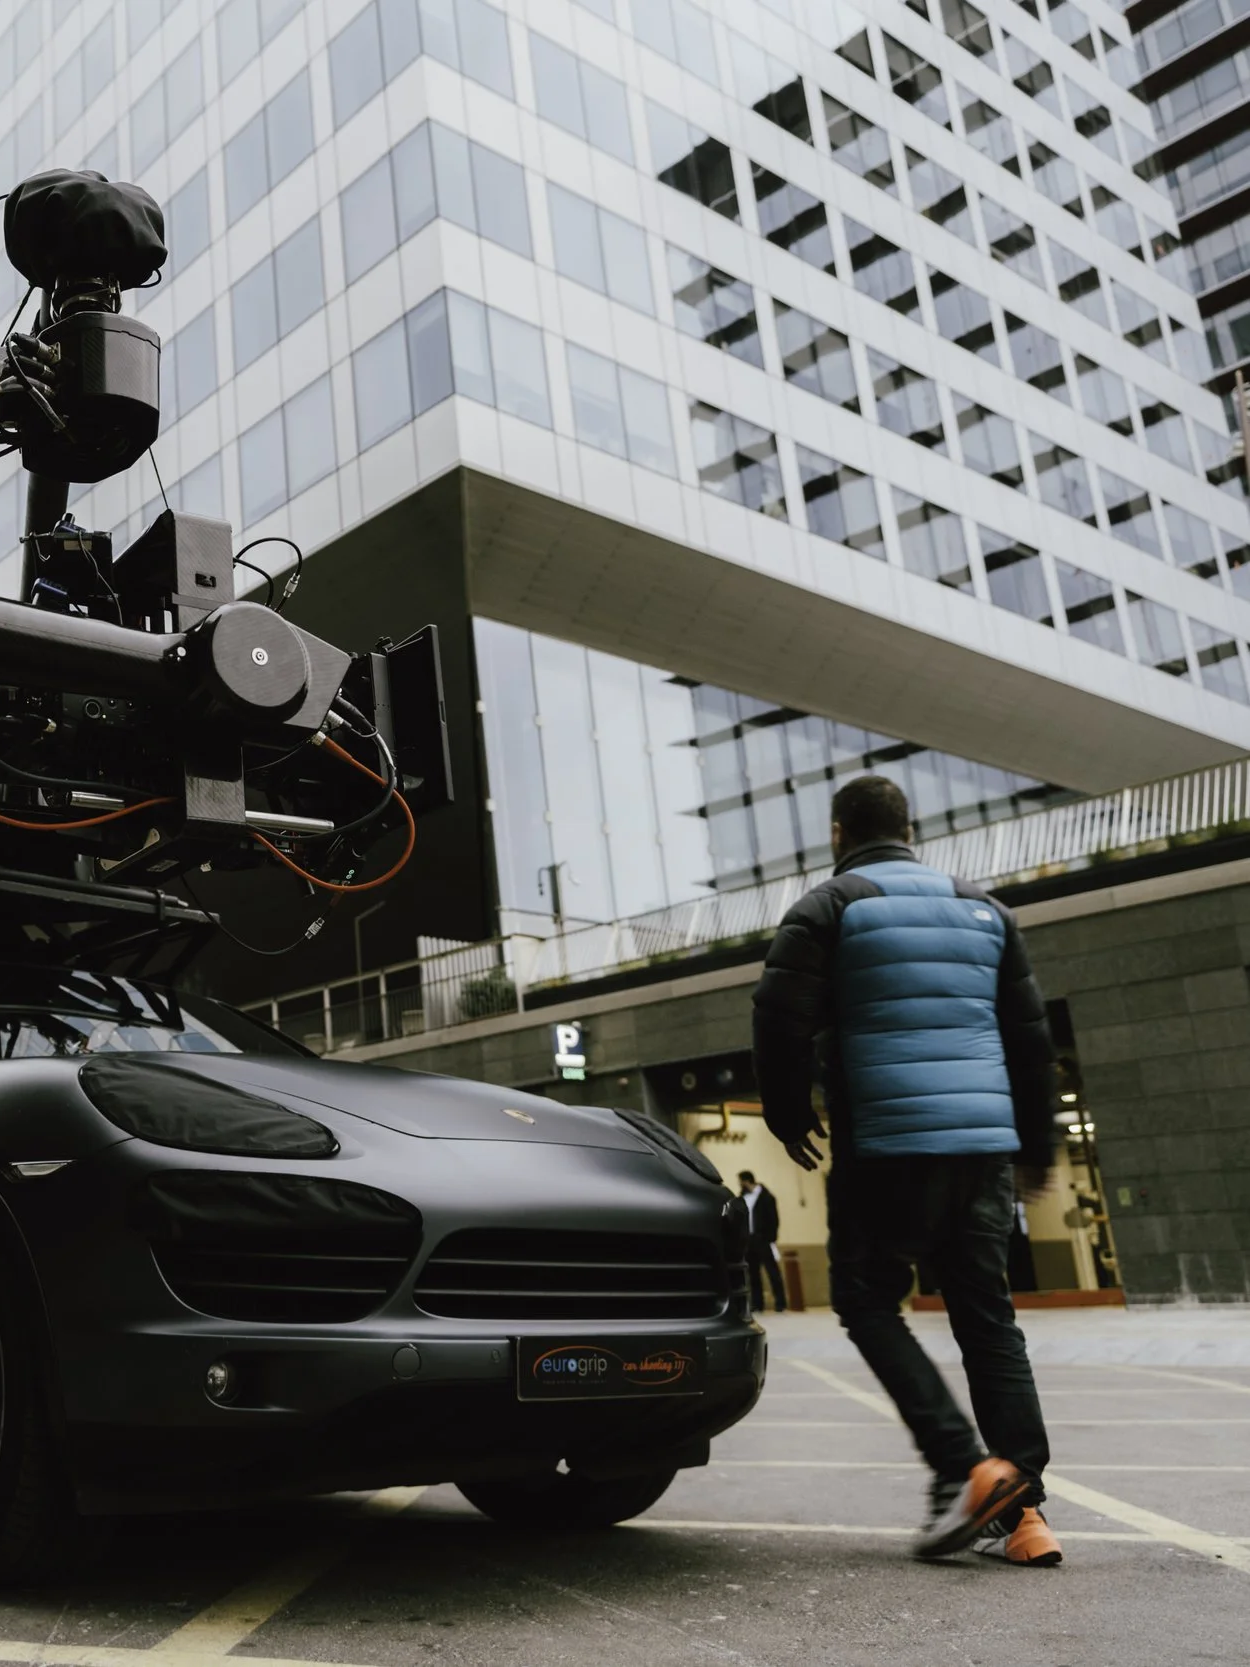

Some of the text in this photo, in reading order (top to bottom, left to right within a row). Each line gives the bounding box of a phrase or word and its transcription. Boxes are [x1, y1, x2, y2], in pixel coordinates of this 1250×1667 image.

[557, 1023, 580, 1055] P
[542, 1353, 608, 1376] eurogrip
[622, 1362, 638, 1372] car
[639, 1357, 672, 1372] shooting
